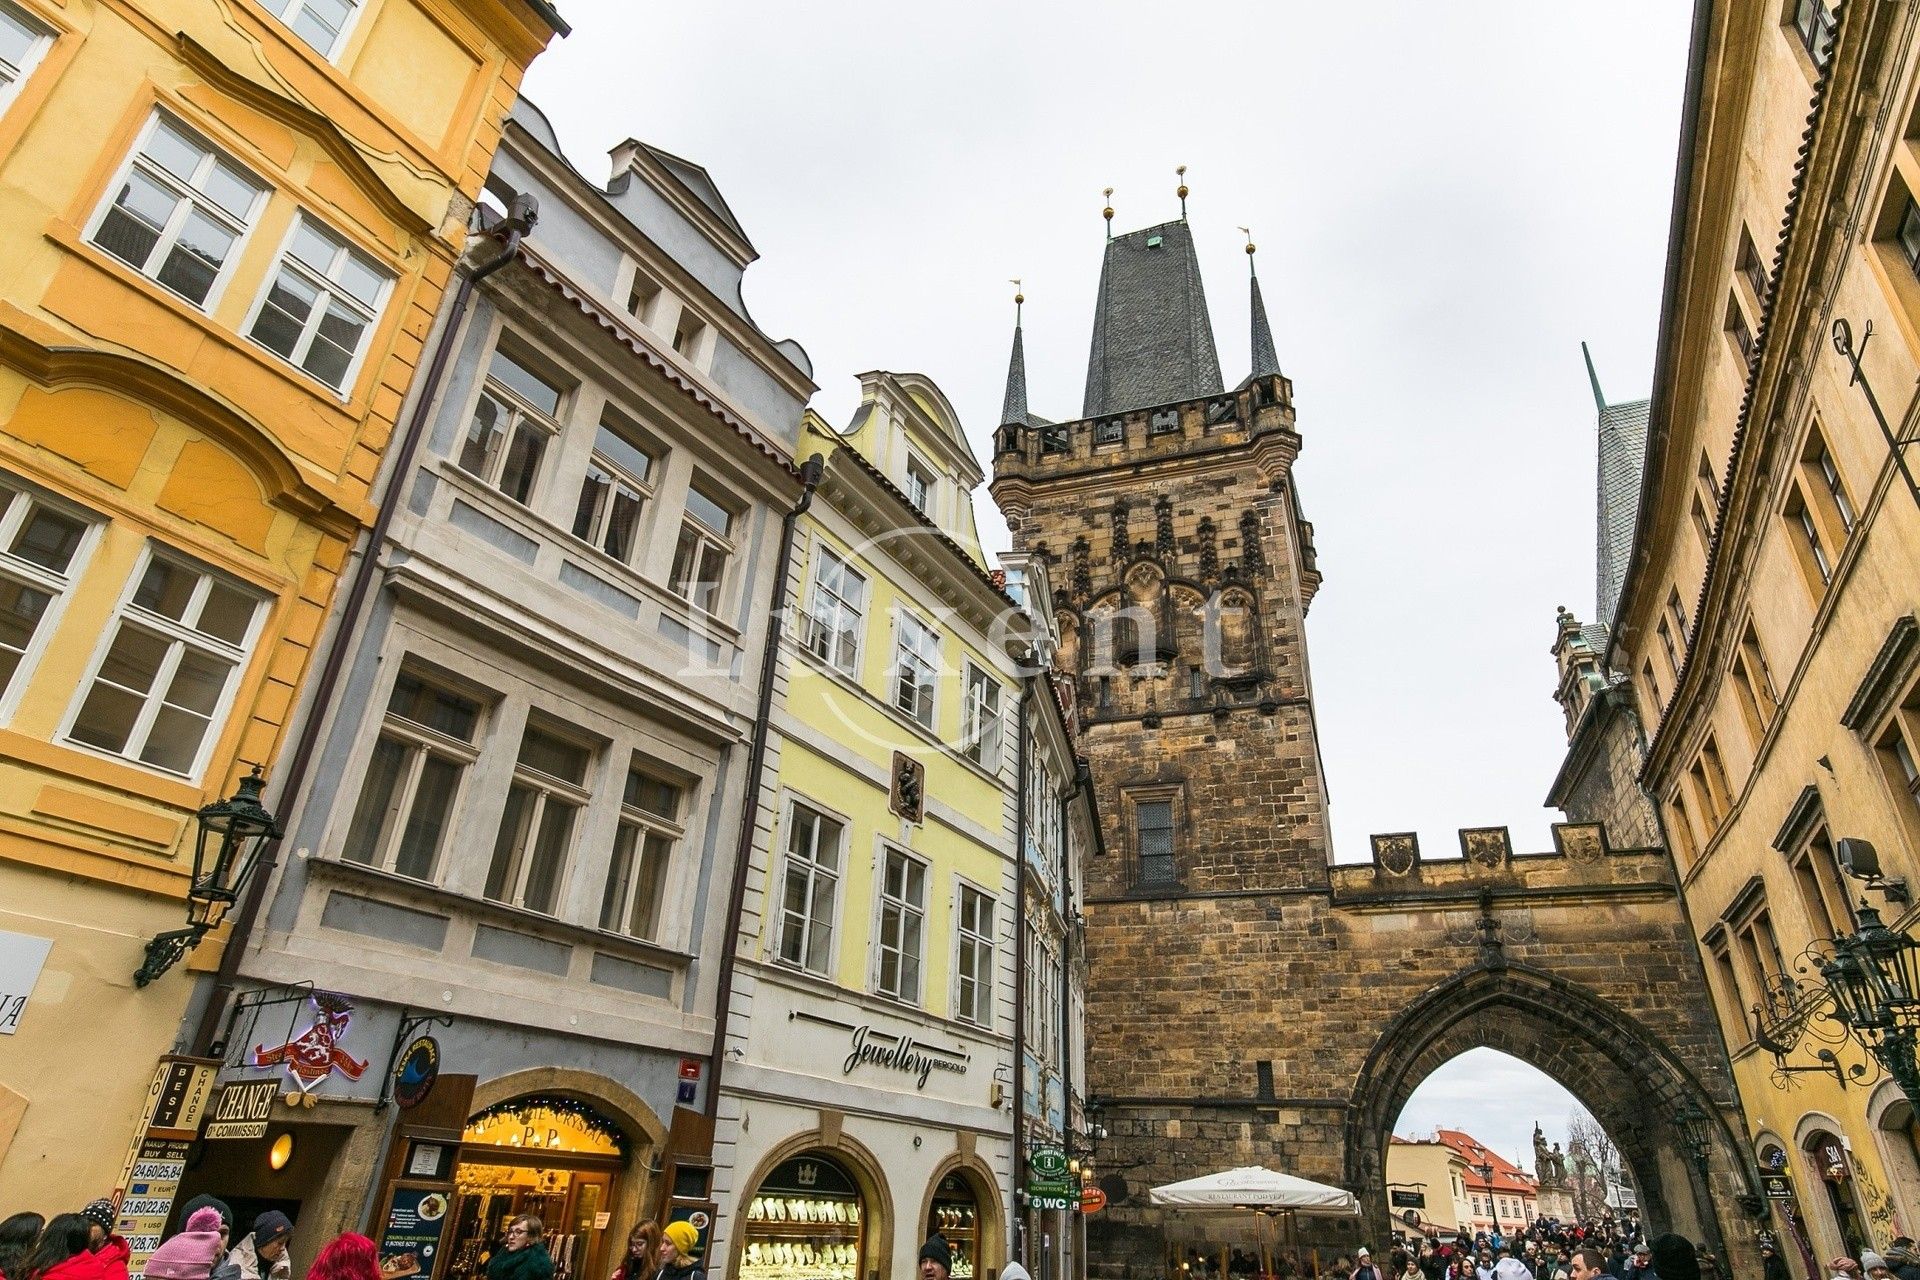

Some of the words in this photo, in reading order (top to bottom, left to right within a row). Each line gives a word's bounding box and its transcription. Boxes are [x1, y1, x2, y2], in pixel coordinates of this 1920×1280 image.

[843, 1025, 933, 1089] Jewellery
[933, 1058, 967, 1075] BERGOLD
[164, 1068, 187, 1121] BEST
[185, 1069, 209, 1123] CHANGE
[215, 1083, 278, 1121] CHANGE
[216, 1124, 267, 1138] COMMISSION
[144, 1150, 161, 1159] BUY
[166, 1151, 184, 1160] SELL
[1034, 1149, 1053, 1159] TOURIST
[133, 1163, 157, 1178] 24,60
[157, 1164, 182, 1179] 25,84
[121, 1200, 146, 1214] 21,60
[145, 1200, 171, 1214] 22,86
[1042, 1198, 1067, 1209] WC
[134, 1236, 159, 1251] 28,78
